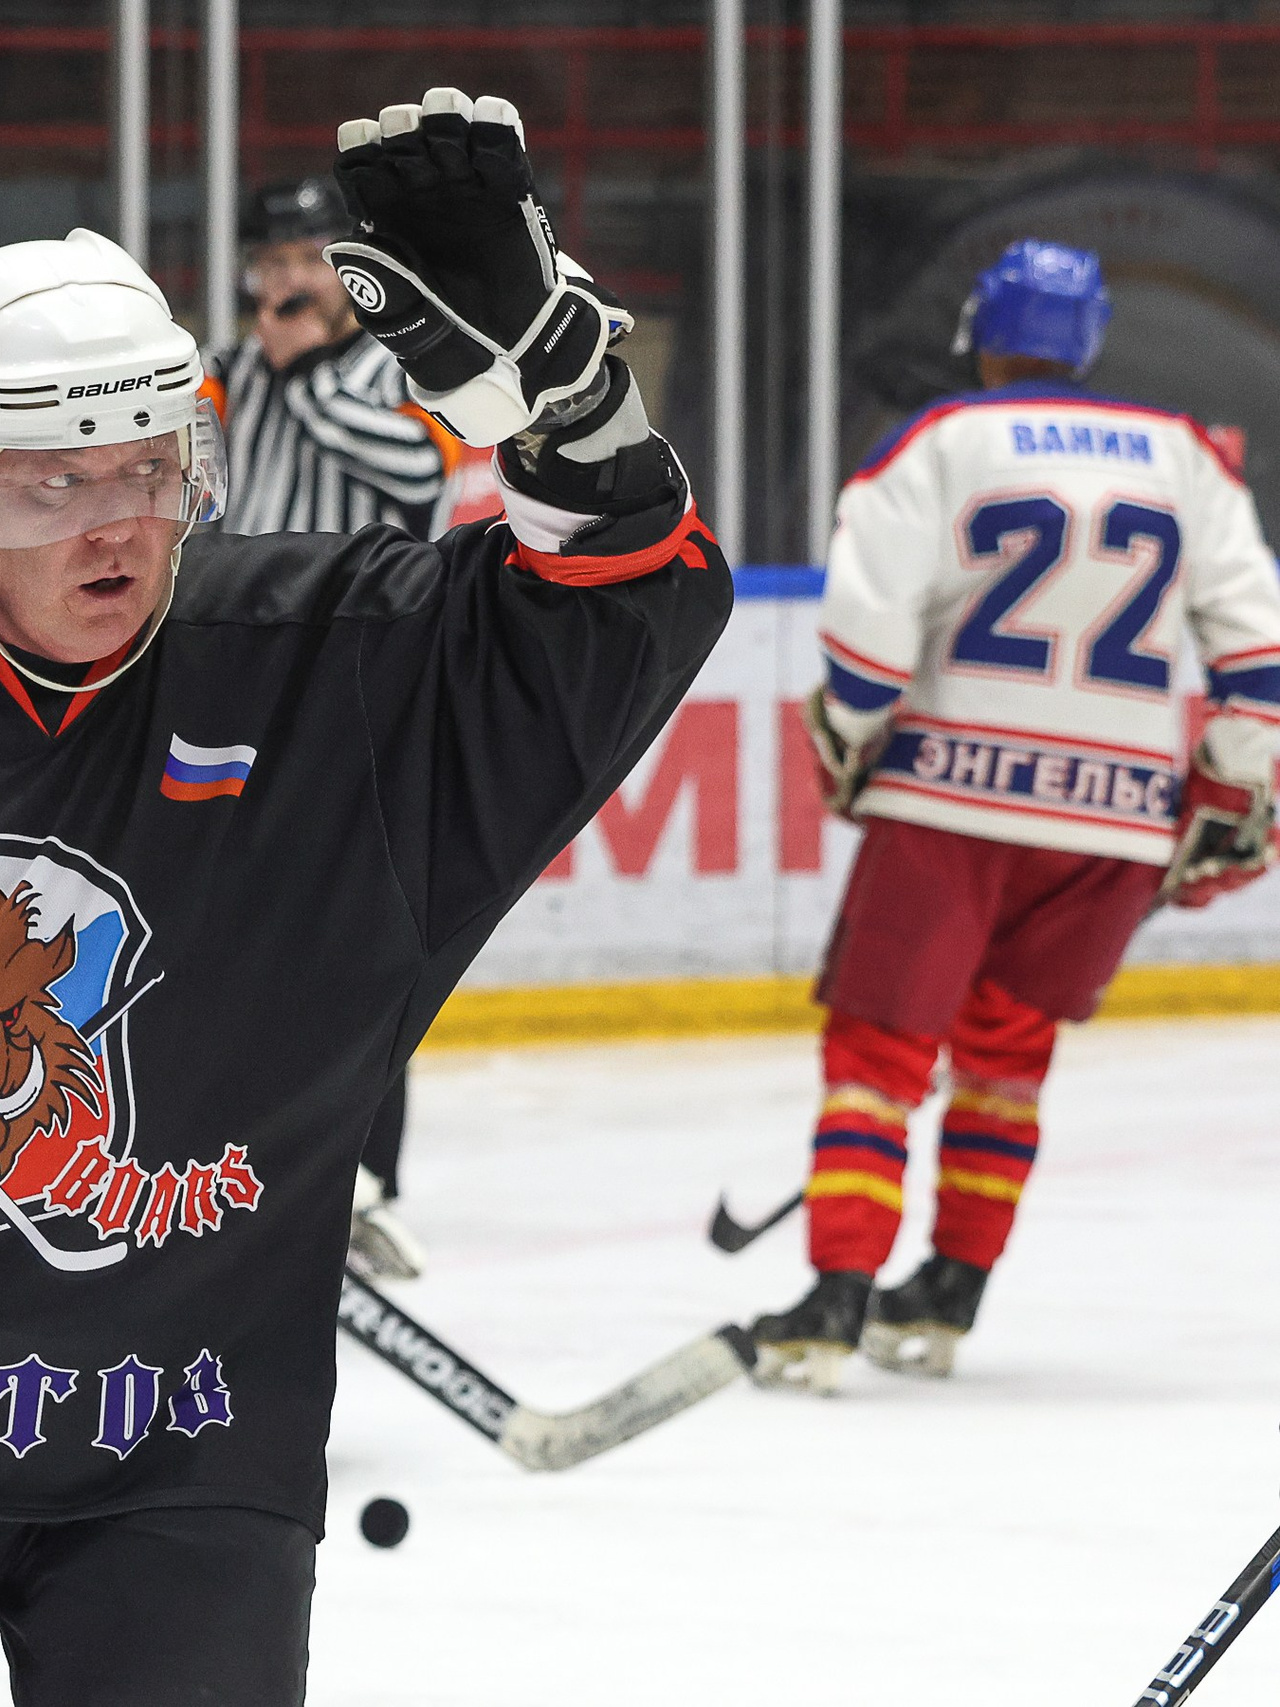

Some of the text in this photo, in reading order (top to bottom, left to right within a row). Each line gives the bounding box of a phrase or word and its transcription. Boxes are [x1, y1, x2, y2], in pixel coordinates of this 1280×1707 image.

[543, 303, 578, 354] WARRIOR
[66, 374, 152, 399] BAUER
[1011, 423, 1153, 463] ВАНИН
[944, 492, 1183, 703] 22
[913, 735, 1175, 815] ЭНГЕЛЬС
[42, 1135, 265, 1249] BOARS
